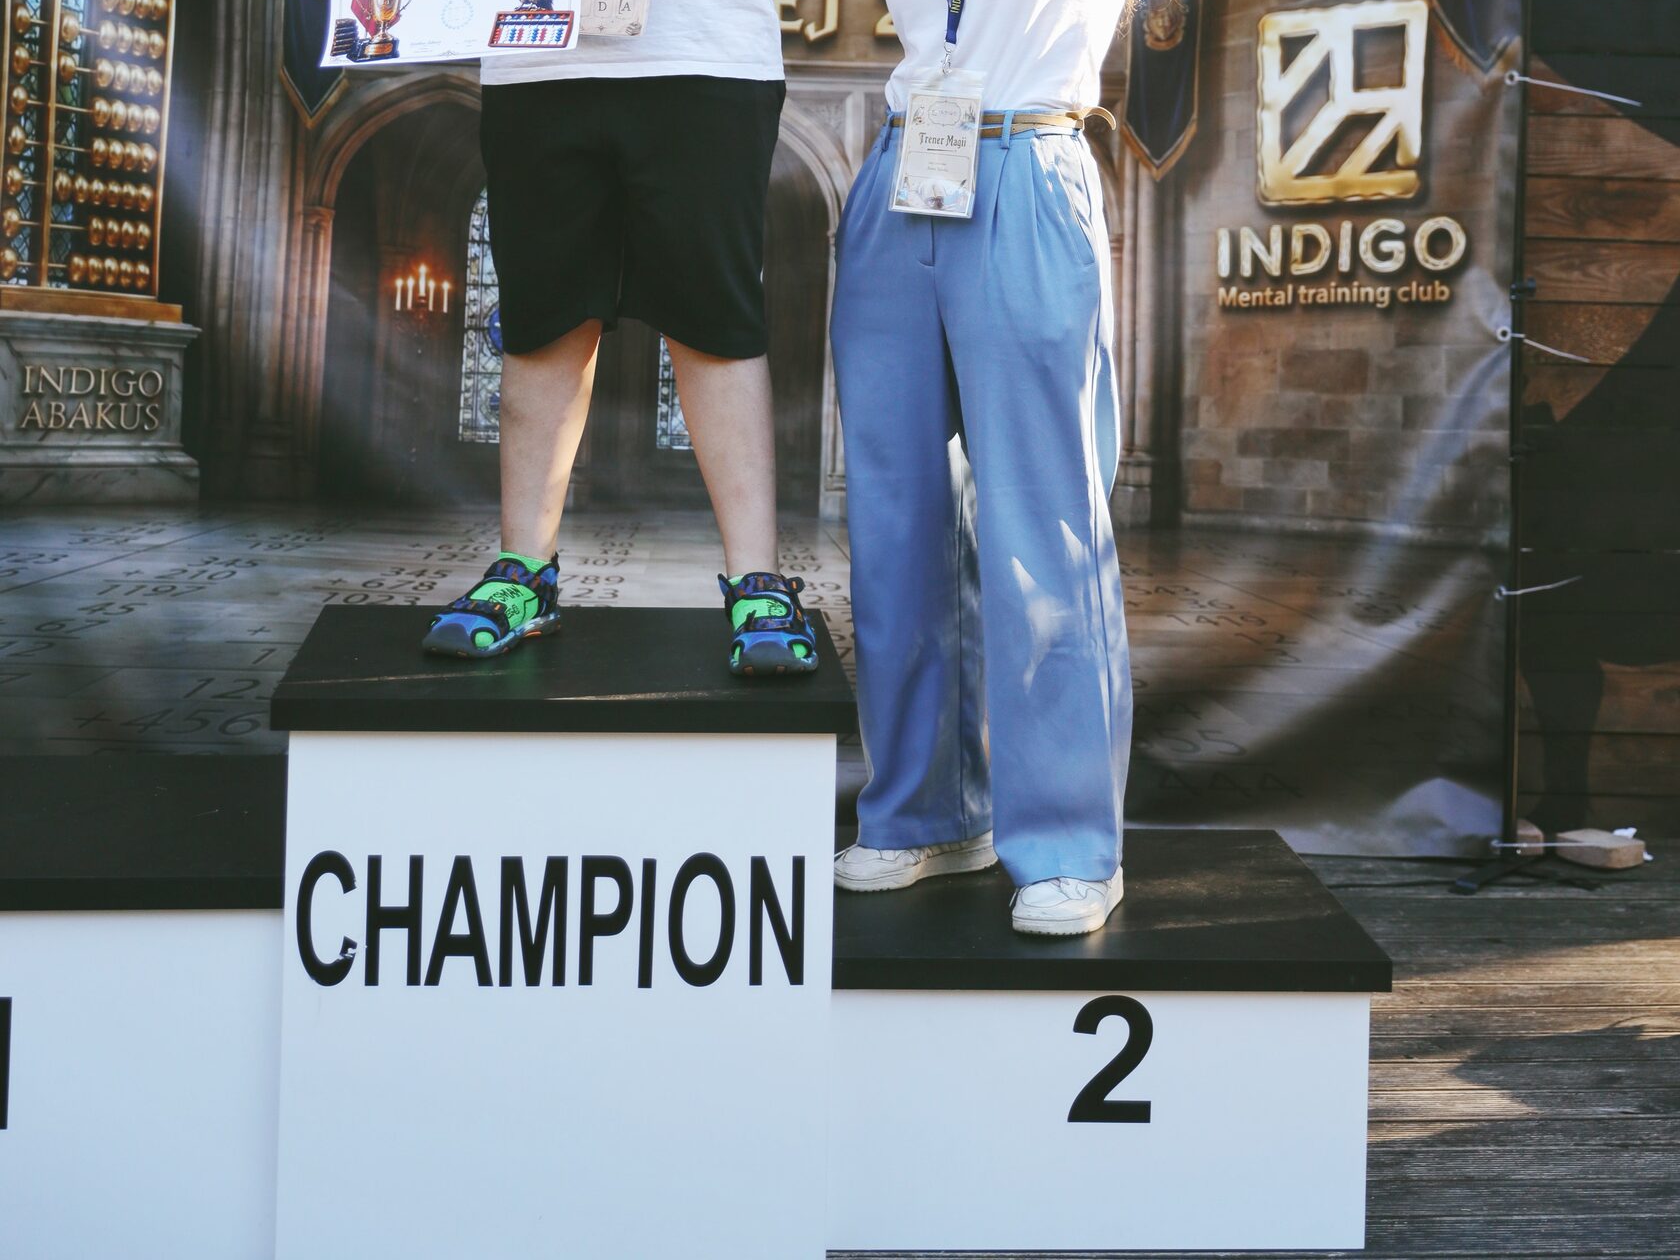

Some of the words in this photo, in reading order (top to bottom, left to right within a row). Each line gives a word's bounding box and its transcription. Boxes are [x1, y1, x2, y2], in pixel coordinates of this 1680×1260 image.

[919, 132, 945, 146] Trener
[946, 134, 967, 149] Magii
[1217, 215, 1467, 278] INDIGO
[1218, 284, 1293, 307] Mental
[1299, 282, 1391, 308] training
[1397, 280, 1450, 303] club
[23, 364, 163, 397] INDIGO
[18, 400, 161, 431] ABAKUS
[154, 568, 237, 581] 210
[380, 566, 453, 580] 345
[96, 583, 208, 598] 1197
[361, 578, 438, 592] 678
[77, 601, 149, 616] 45
[322, 592, 422, 605] 1023
[35, 618, 110, 634] 67
[182, 677, 272, 700] 12
[119, 708, 269, 737] 456
[297, 851, 805, 988] CHAMPION
[1067, 995, 1154, 1123] 2
